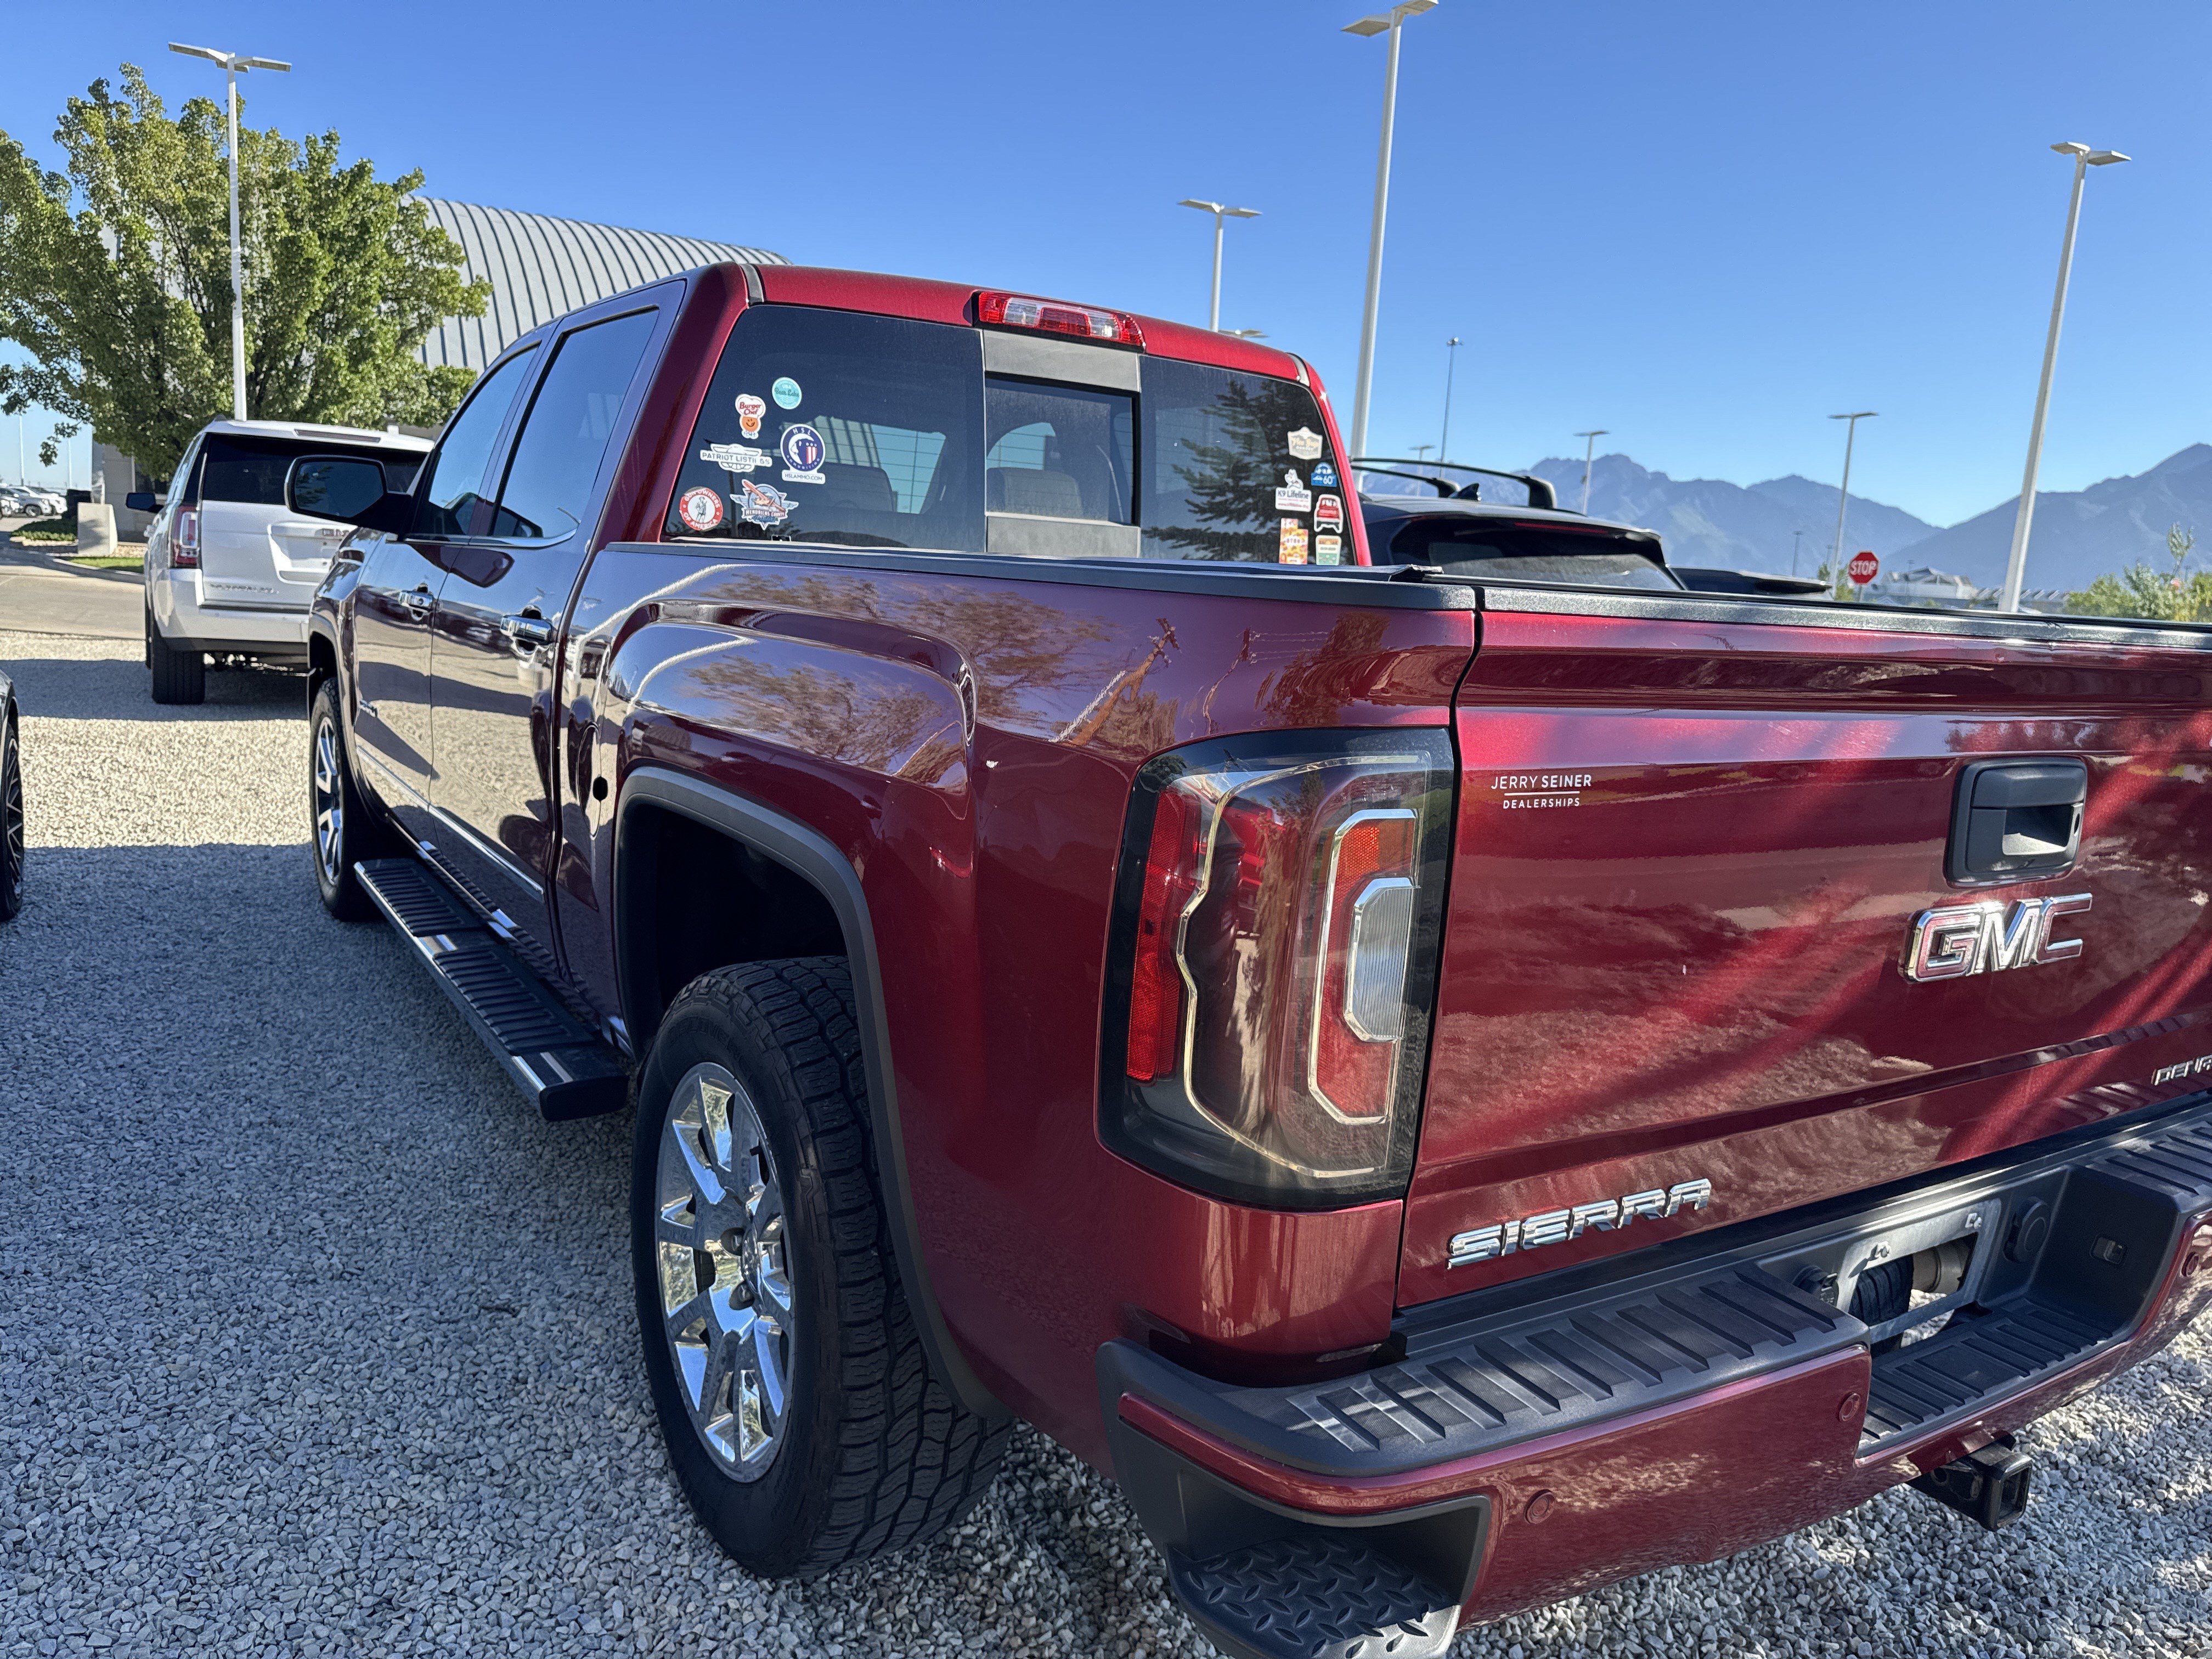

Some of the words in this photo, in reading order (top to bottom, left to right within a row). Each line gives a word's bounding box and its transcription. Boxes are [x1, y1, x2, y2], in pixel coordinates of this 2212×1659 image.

[740, 402, 761, 410] Burger
[792, 427, 811, 436] HSL
[702, 452, 733, 461] PATRIOT
[697, 489, 720, 509] OWNERS
[1287, 490, 1309, 499] Lifeline
[684, 512, 691, 521] OF
[690, 518, 718, 530] AMERICA
[1850, 560, 1877, 575] STOP
[1491, 775, 1538, 789] JERRY
[1541, 774, 1592, 788] SEINER
[1503, 797, 1580, 809] DEALERSHIPS
[1898, 893, 2092, 983] GMC
[1447, 1178, 1712, 1270] SIERRA
